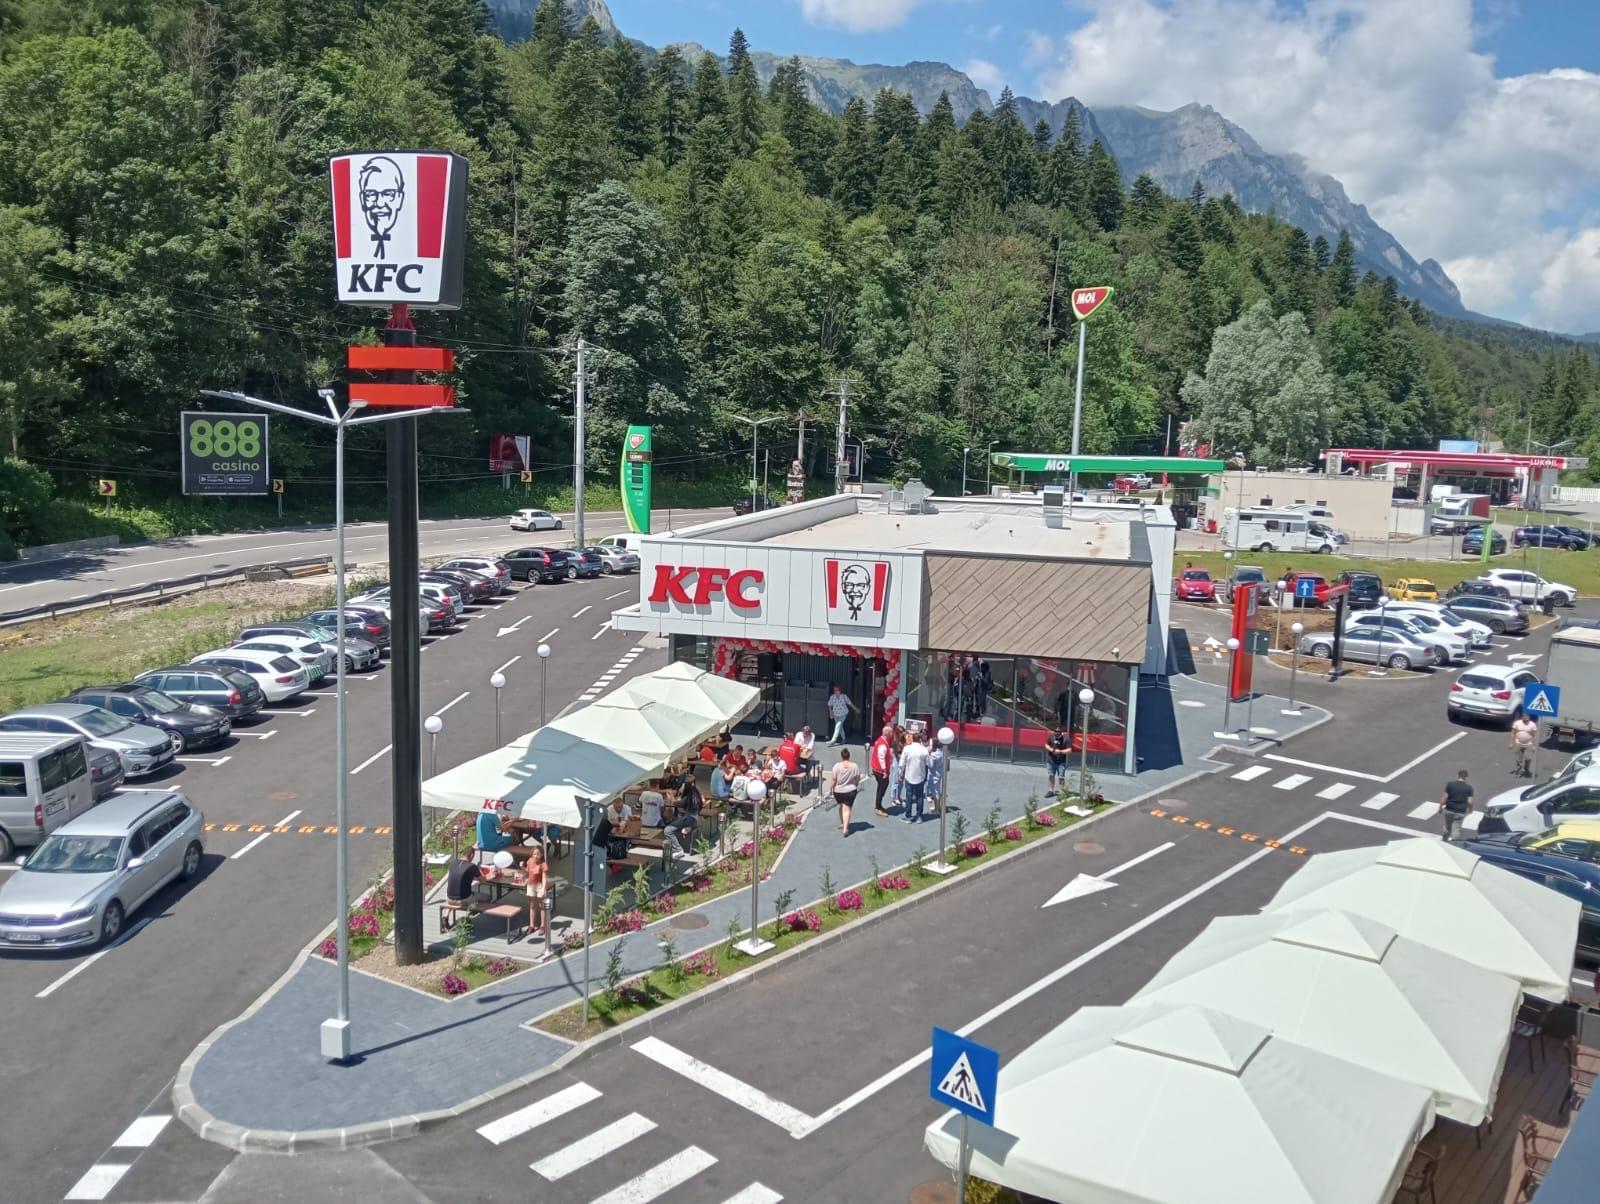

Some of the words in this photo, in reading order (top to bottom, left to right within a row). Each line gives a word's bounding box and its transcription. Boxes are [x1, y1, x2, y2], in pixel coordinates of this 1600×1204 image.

[348, 264, 423, 293] KFC
[1076, 291, 1096, 305] MOL
[190, 419, 260, 458] 888
[212, 460, 260, 471] casino
[1044, 459, 1071, 471] MOL
[1530, 458, 1558, 467] LUKOIL
[647, 564, 765, 609] KFC
[482, 798, 514, 811] KFC
